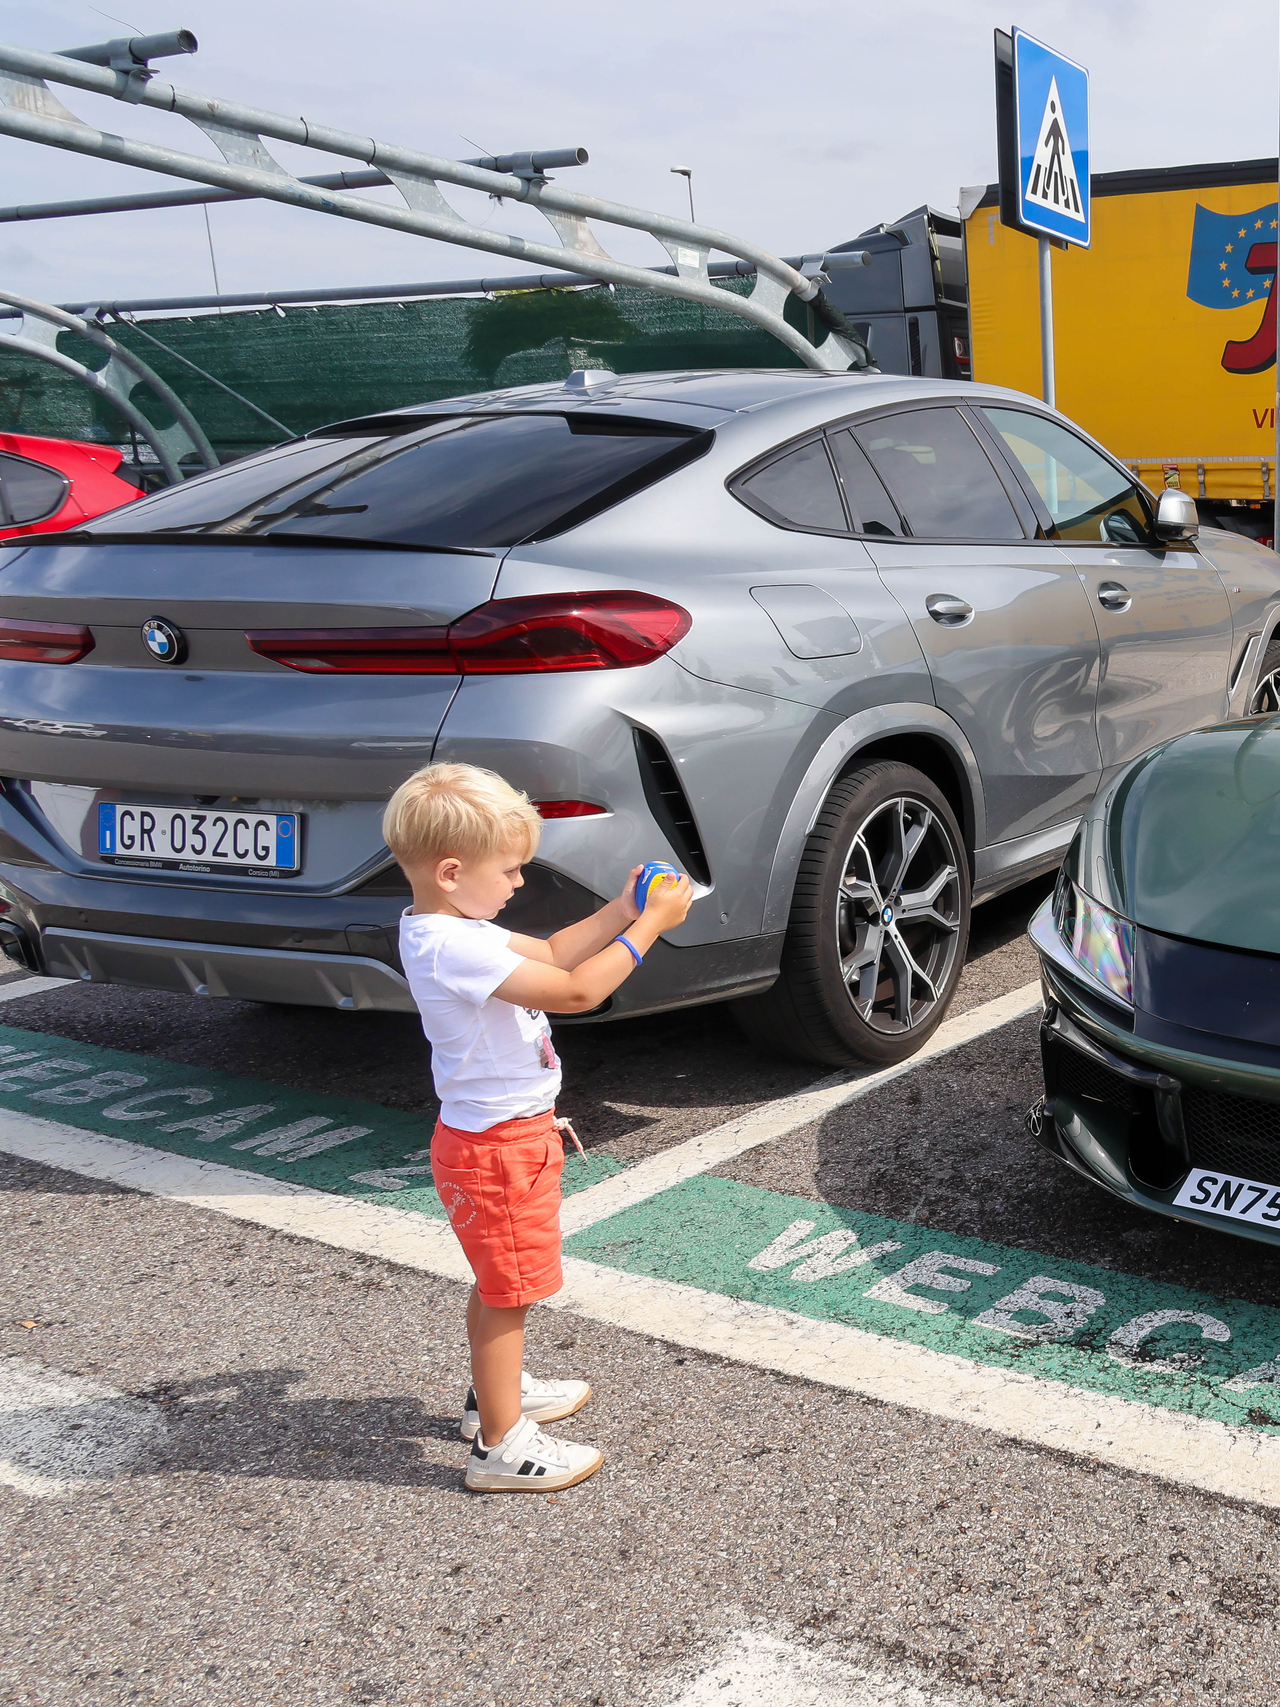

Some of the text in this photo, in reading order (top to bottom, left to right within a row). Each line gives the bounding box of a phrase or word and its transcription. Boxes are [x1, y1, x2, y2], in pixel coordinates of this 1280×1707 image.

[119, 809, 156, 853] GR
[170, 813, 271, 862] 032CG
[179, 863, 210, 873] Autotorino
[248, 868, 280, 878] Corsico (MI)
